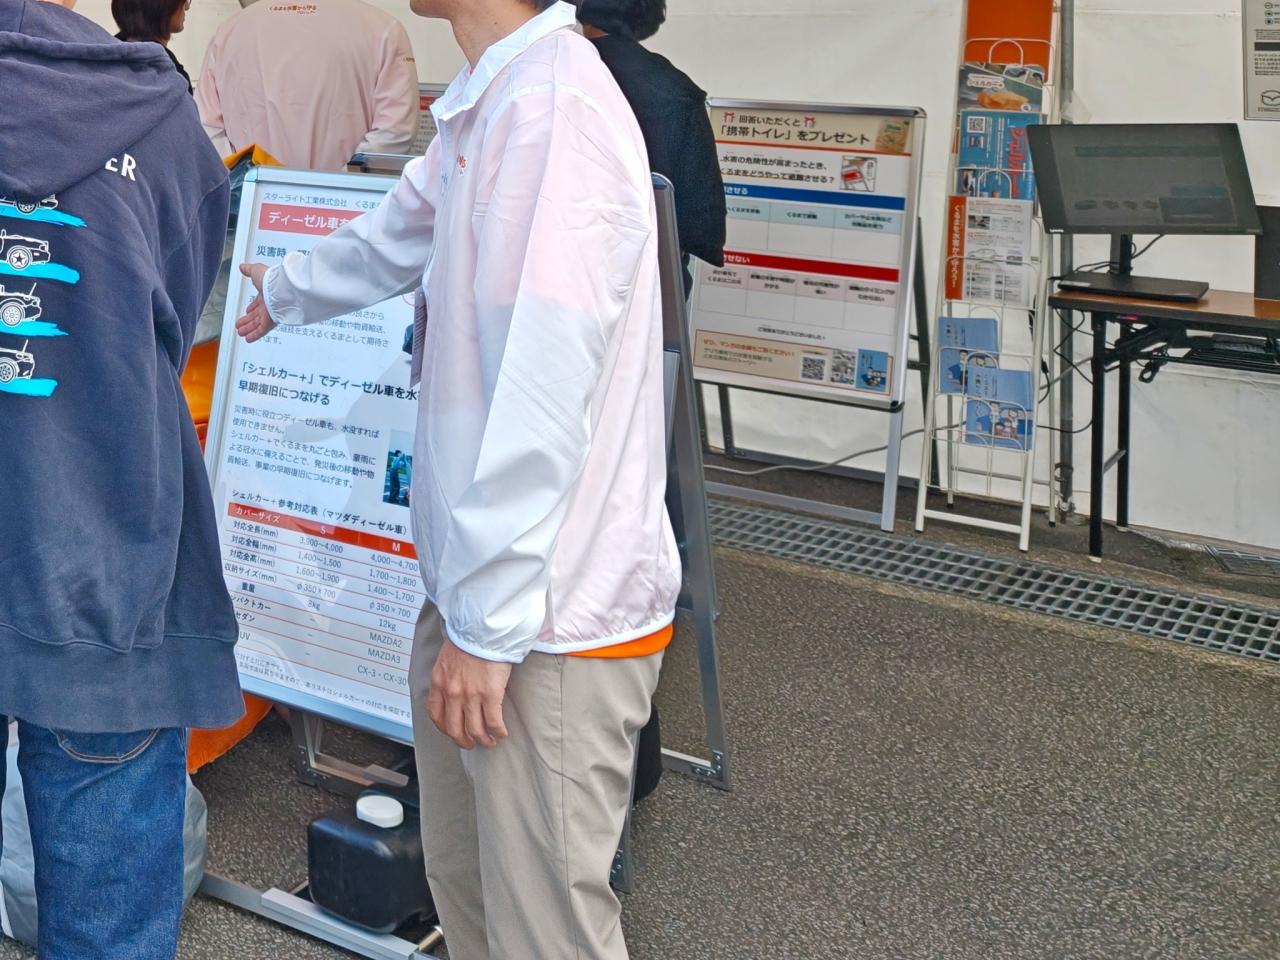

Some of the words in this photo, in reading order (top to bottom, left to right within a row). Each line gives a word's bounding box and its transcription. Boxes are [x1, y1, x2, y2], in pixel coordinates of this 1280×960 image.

[739, 115, 801, 127] 回答いただくと
[264, 192, 348, 207] スターライト工業株式会社
[241, 361, 419, 401] 「シェルカー+」でディーゼル車を水
[238, 379, 331, 406] 早期復旧につなげる
[235, 506, 281, 524] カバーサイズ
[392, 542, 401, 552] M
[369, 632, 403, 648] MAZDA2
[367, 647, 401, 664] MAZDA3
